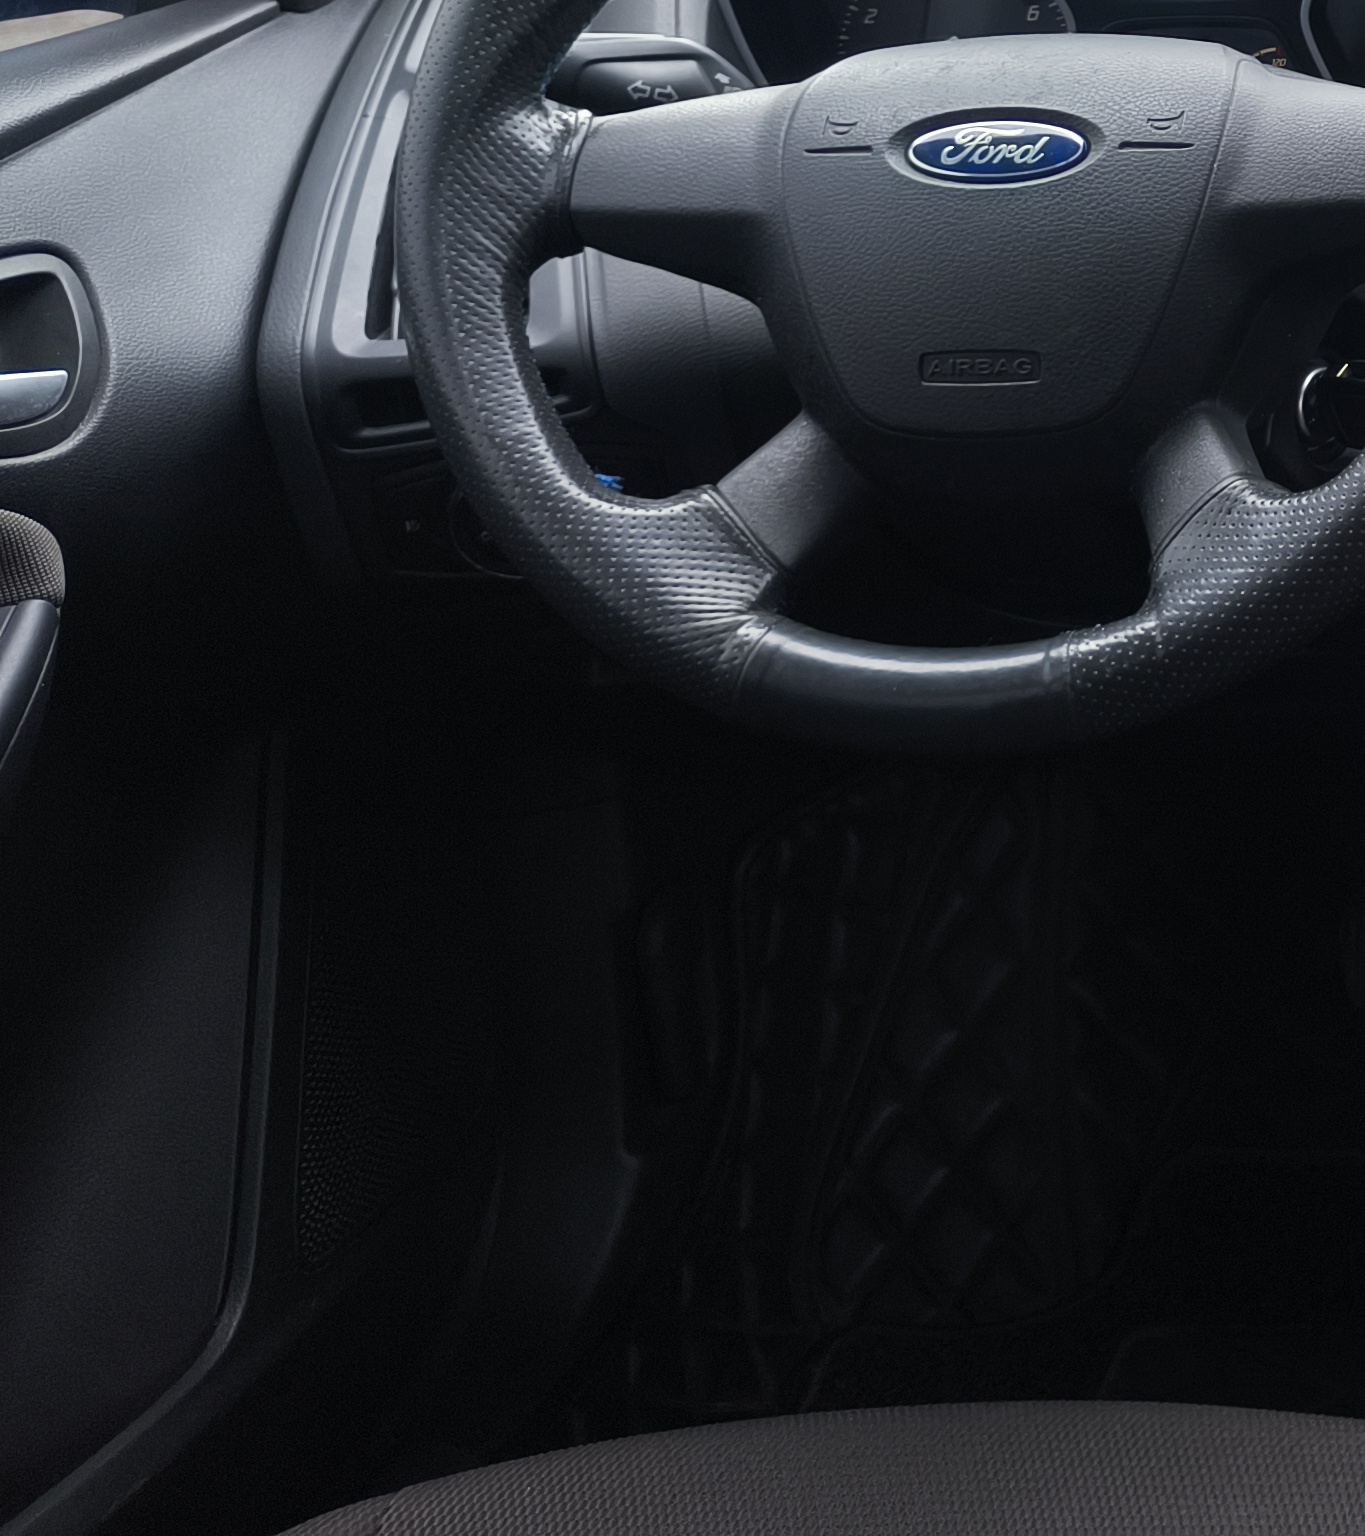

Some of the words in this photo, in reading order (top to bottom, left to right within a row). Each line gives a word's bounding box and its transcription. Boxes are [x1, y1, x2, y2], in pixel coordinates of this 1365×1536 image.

[864, 8, 878, 24] 2
[1026, 5, 1040, 21] 6
[940, 126, 1050, 165] Ford
[927, 357, 1033, 378] AIRBAG
